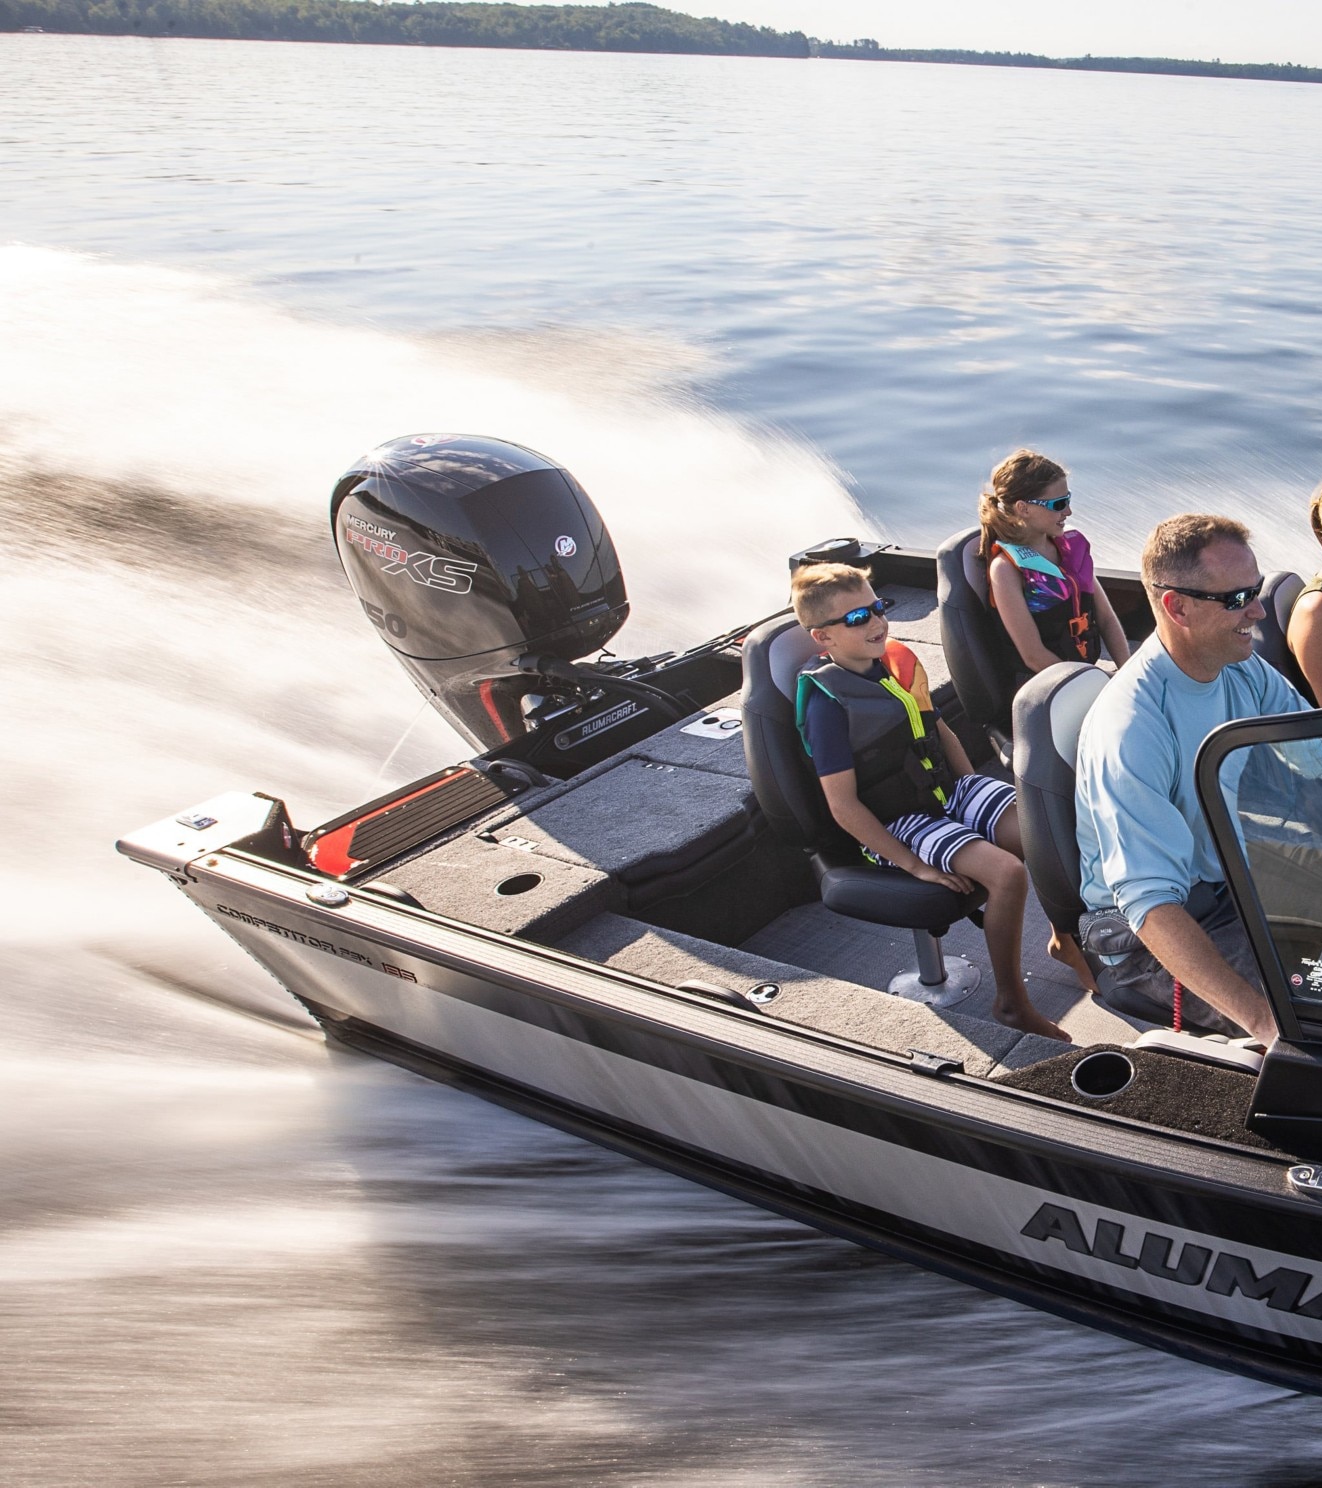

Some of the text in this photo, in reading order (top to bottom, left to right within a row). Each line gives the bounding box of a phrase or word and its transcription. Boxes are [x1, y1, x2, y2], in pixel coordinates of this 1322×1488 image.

[346, 513, 397, 541] MERCURY
[581, 702, 638, 736] ALUMACRAFT
[216, 903, 337, 954] COMPETITOR
